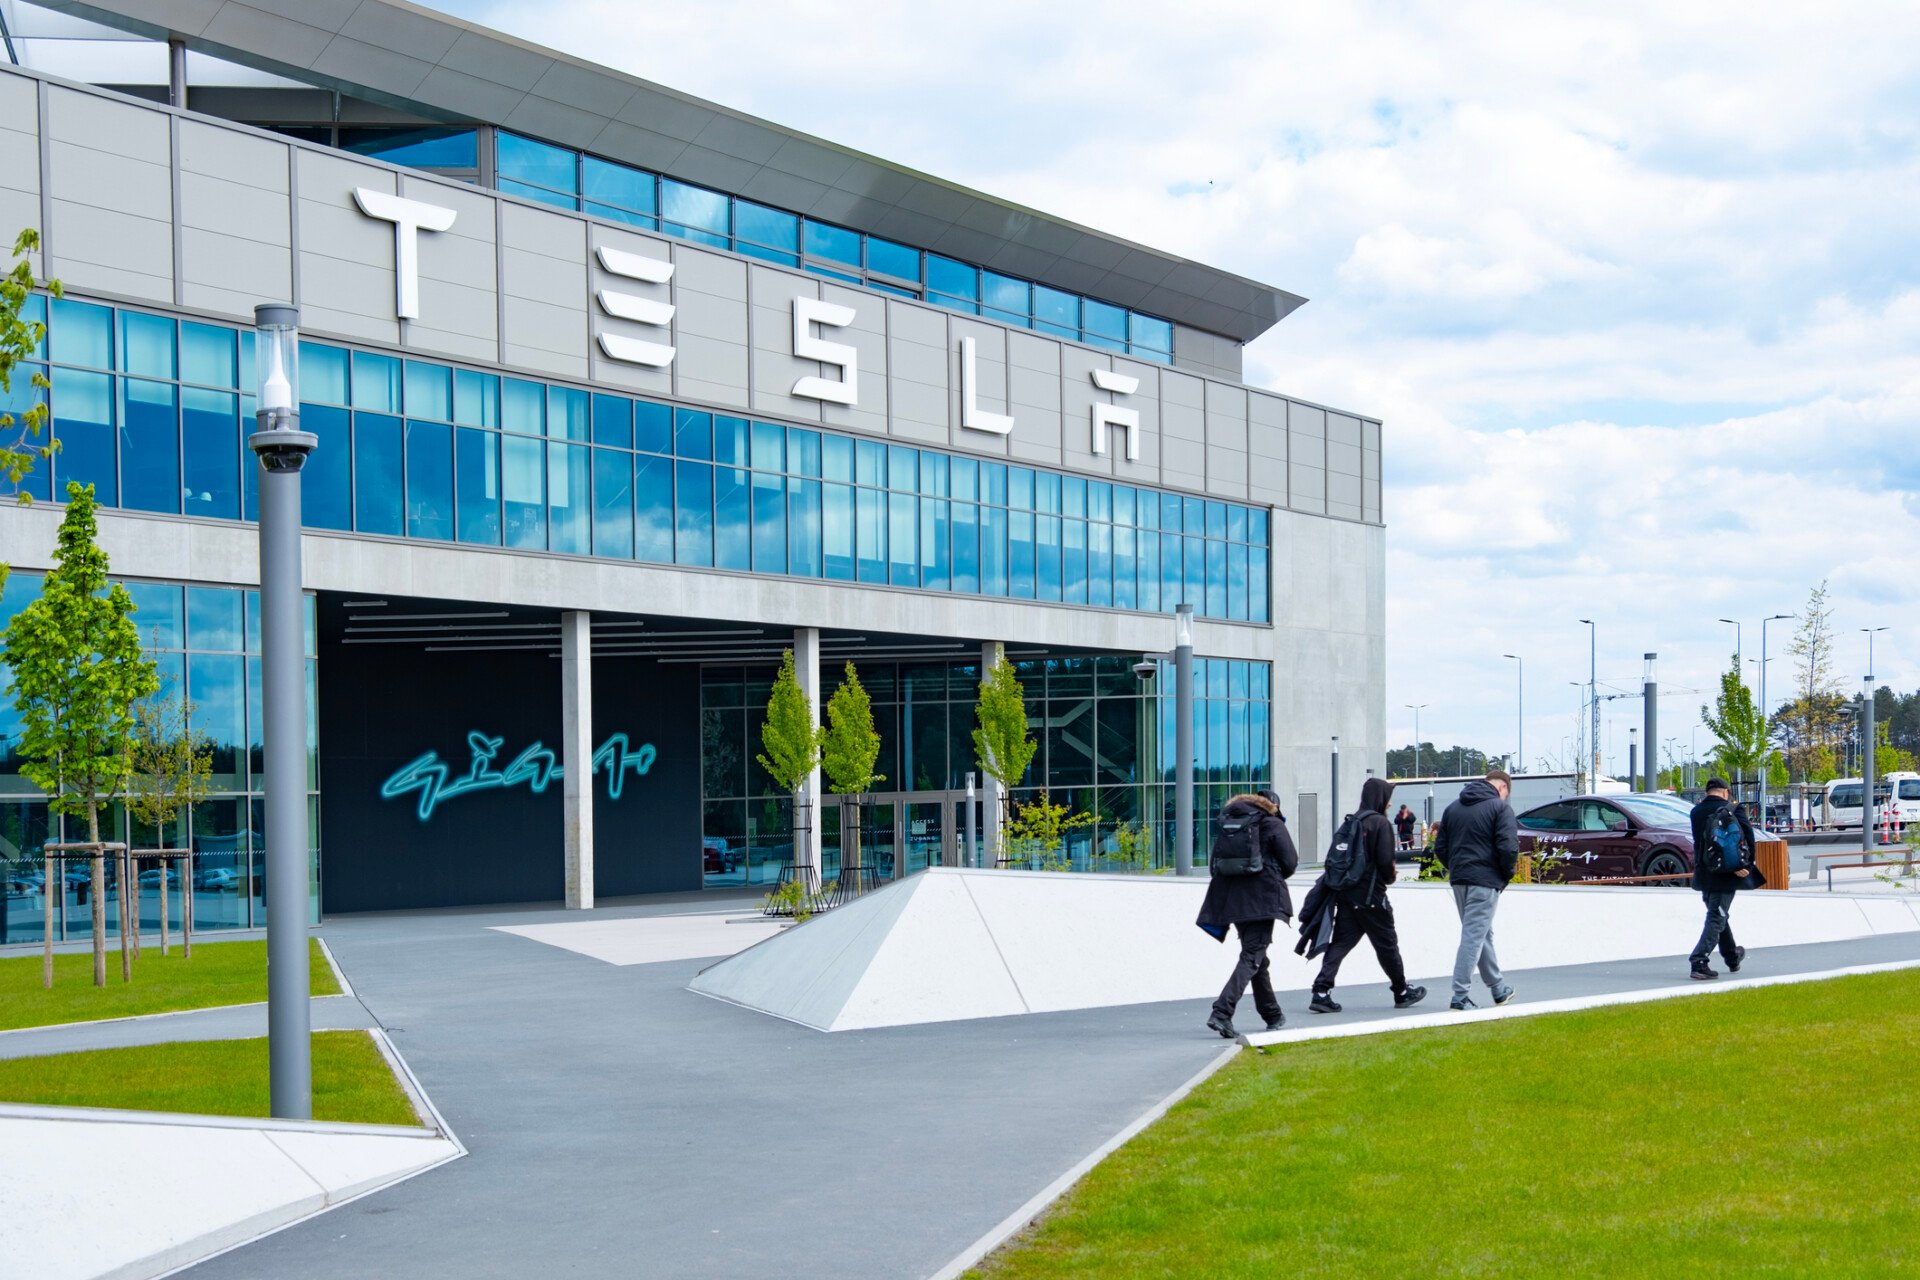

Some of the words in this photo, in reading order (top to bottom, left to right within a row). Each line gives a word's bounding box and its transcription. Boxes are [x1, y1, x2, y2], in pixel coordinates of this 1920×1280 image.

[352, 186, 1141, 462] TESLA
[1536, 835, 1549, 843] WE
[1551, 835, 1569, 843] ARE
